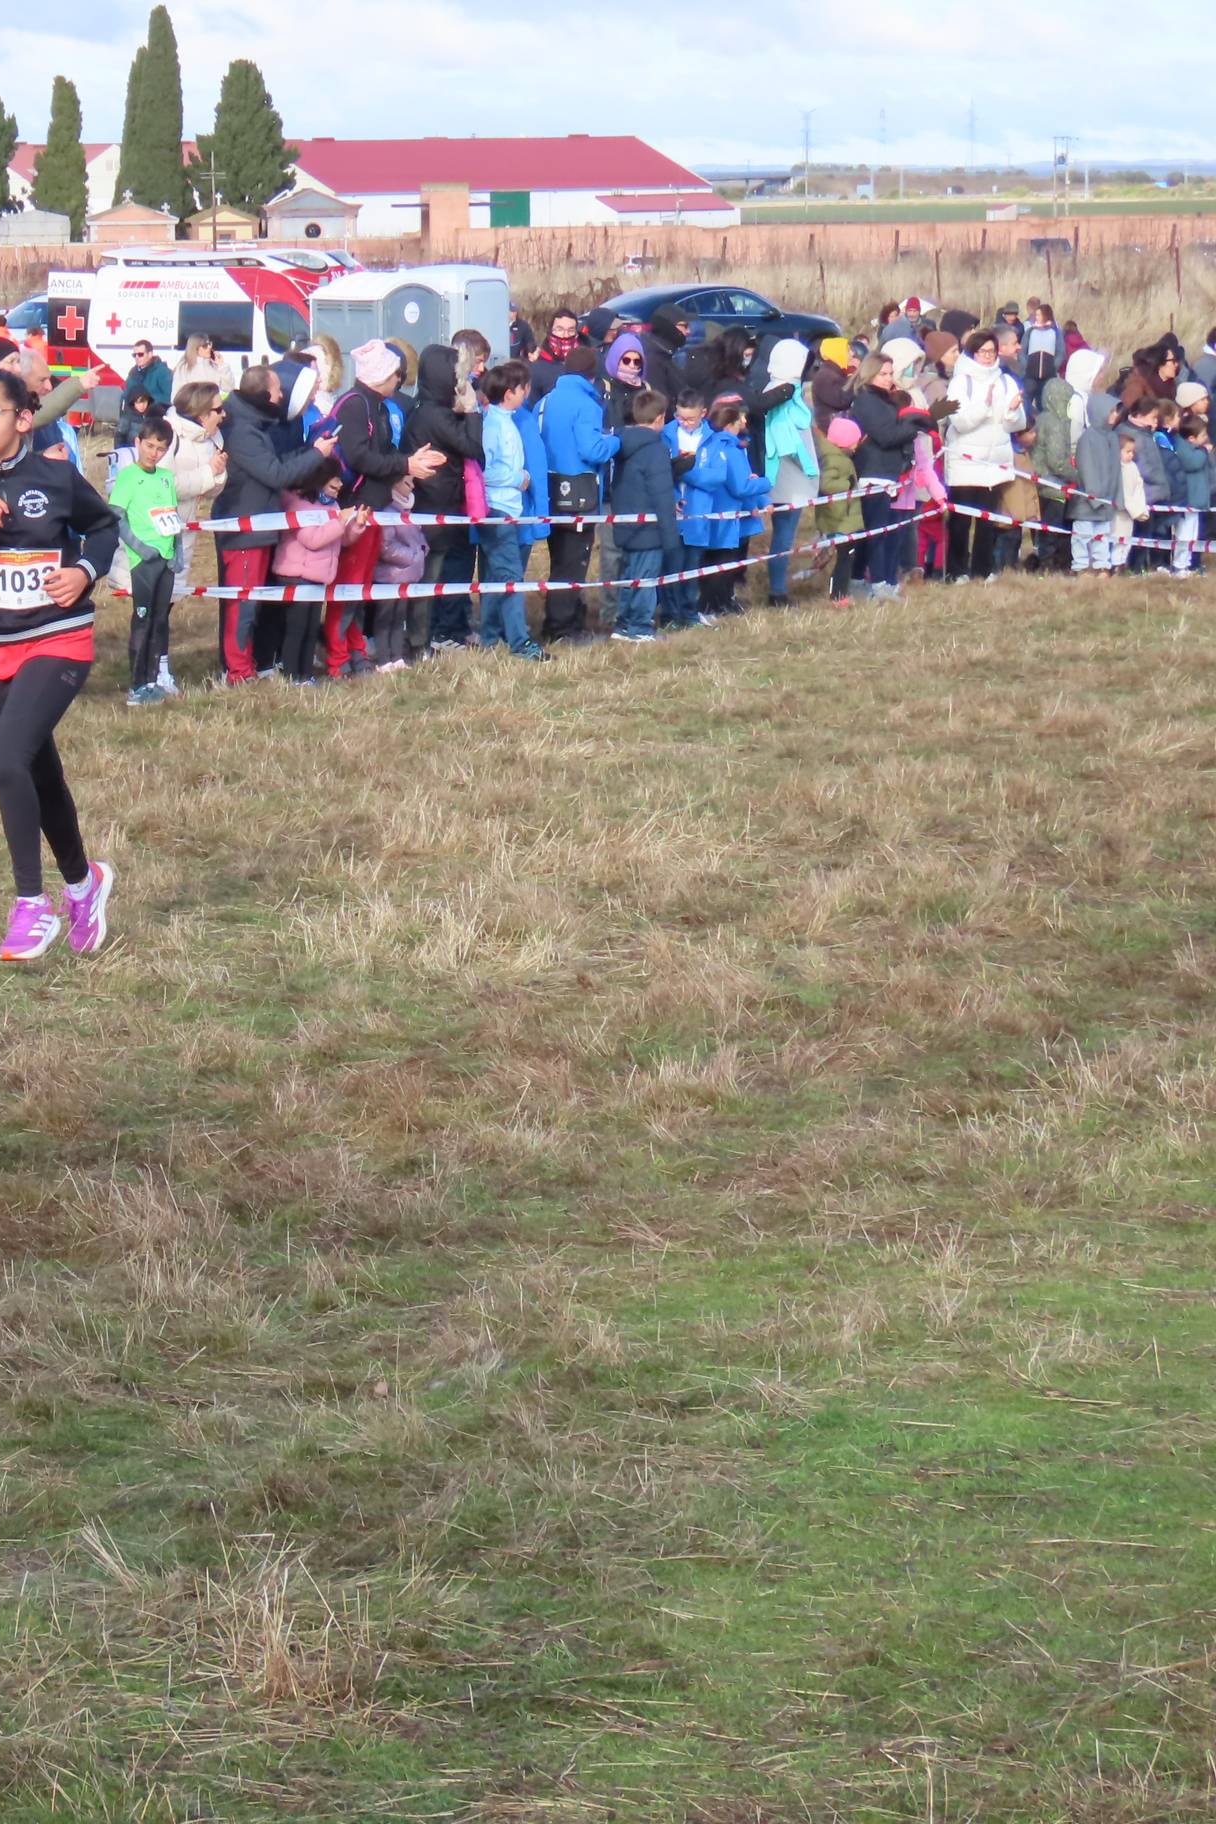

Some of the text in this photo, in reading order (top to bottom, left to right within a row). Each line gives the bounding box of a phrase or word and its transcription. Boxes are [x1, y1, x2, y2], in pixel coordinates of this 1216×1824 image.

[160, 280, 220, 290] AMBULANCIA
[159, 290, 183, 299] VITAL
[125, 316, 175, 332] Cruz Roja
